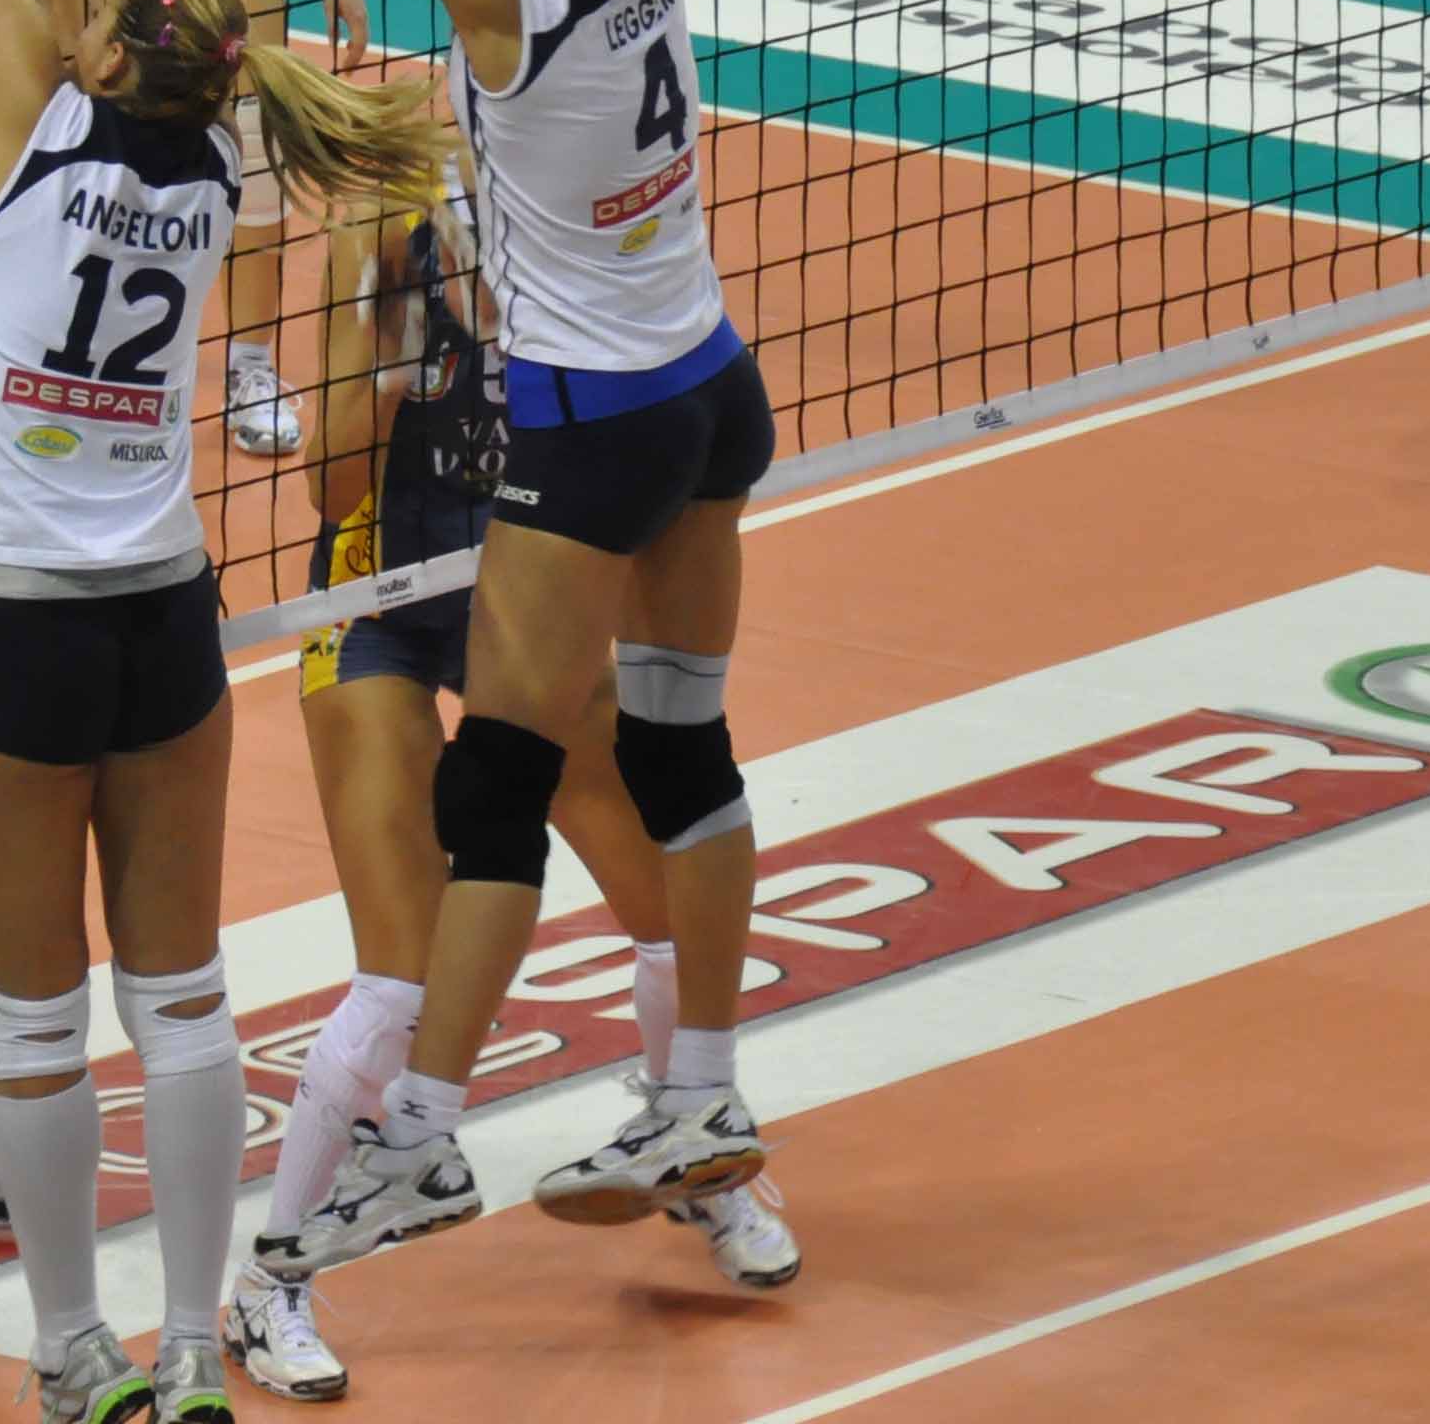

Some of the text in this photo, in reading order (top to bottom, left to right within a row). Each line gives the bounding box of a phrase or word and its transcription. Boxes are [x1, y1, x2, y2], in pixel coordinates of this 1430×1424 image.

[634, 33, 687, 152] 4
[595, 158, 691, 221] DESPA
[41, 253, 187, 386] 12
[6, 376, 160, 418] DESPAR
